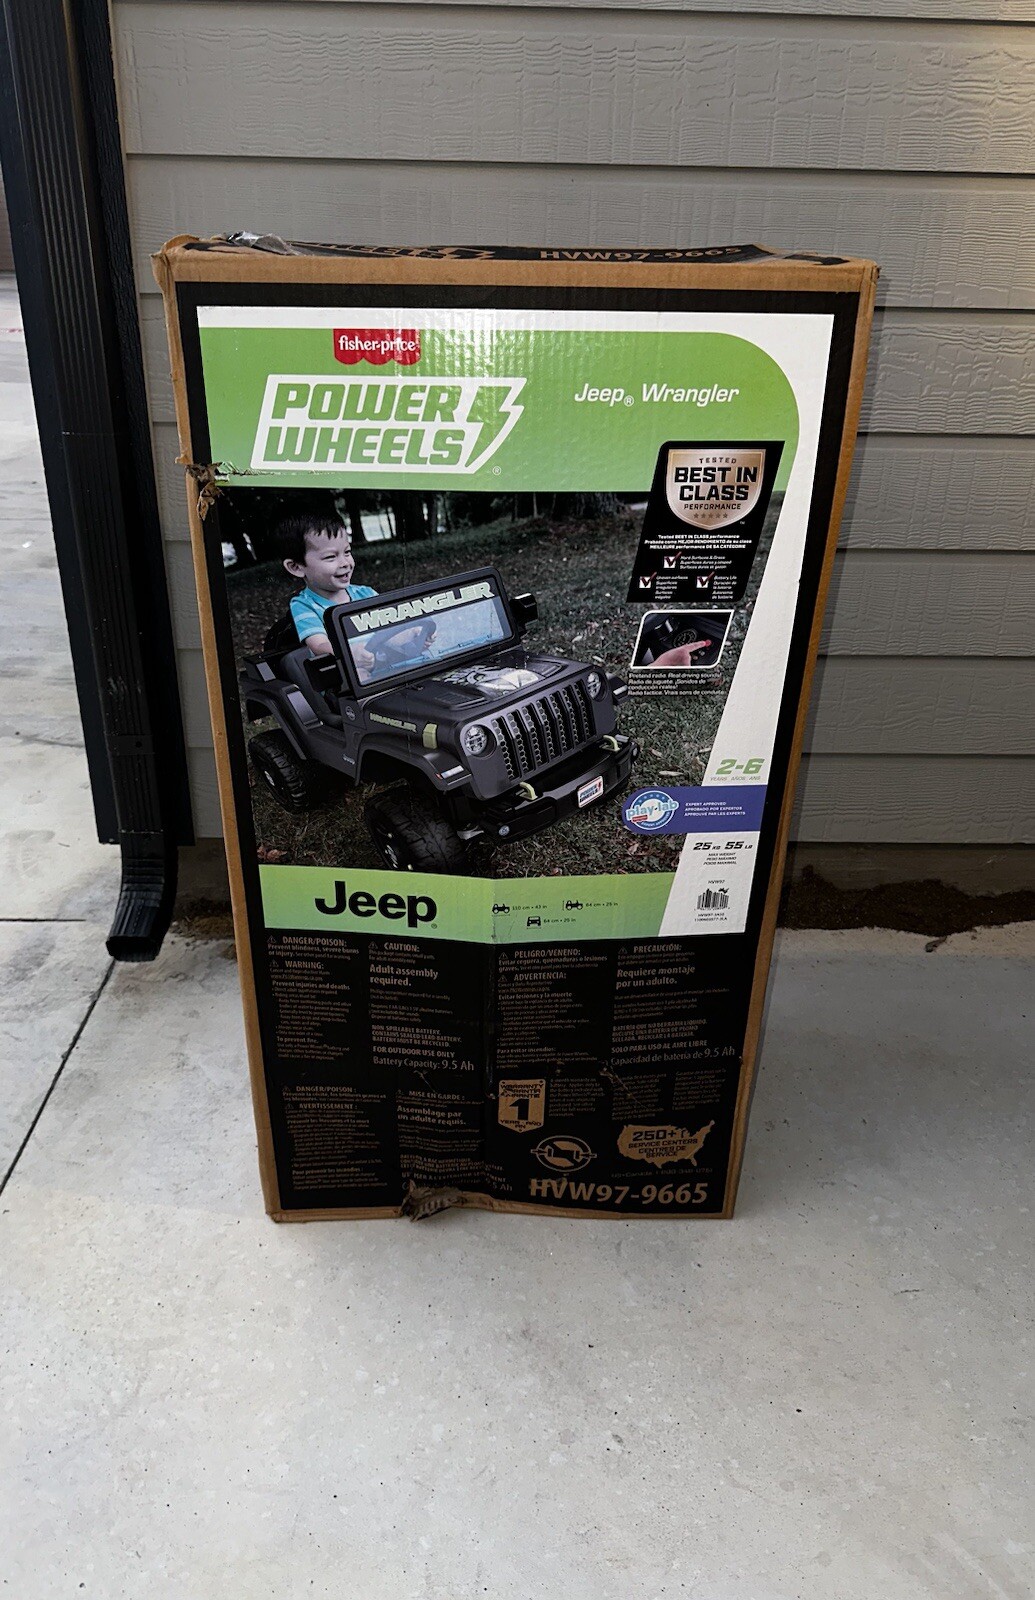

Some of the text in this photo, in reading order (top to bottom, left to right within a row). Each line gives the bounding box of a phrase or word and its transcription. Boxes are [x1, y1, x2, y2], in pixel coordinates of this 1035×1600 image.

[270, 382, 463, 423] POWER
[641, 383, 740, 408] Wrangler
[263, 425, 467, 467] WHEELS
[675, 466, 759, 483] BEST IN
[680, 485, 750, 501] CLASS
[350, 581, 495, 632] WRANGLER
[370, 712, 417, 732] WRANGLER
[715, 758, 765, 775] 2-6
[693, 842, 712, 850] 25
[724, 841, 745, 849] 55
[282, 936, 347, 947] DANGER/POISON:
[384, 942, 420, 952] CAUTION:
[633, 943, 682, 953] PRECAUCIÓN:
[514, 948, 581, 958] PELIGRO/VENENO:
[285, 960, 324, 970] WARNING:
[617, 965, 696, 979] Requiere montaje
[370, 964, 439, 981] Adult assembly
[513, 972, 567, 981] ADVERTENCIA:
[370, 976, 412, 987] required.
[616, 980, 631, 991] por
[646, 976, 678, 985] adulto.
[689, 1039, 708, 1047] LIBRE
[387, 1047, 421, 1055] OUTDOOR
[611, 1056, 650, 1068] Capacidad
[652, 1054, 661, 1062] de
[692, 1051, 702, 1059] de
[703, 1047, 719, 1058] 9.5
[721, 1045, 736, 1056] Ah
[372, 1056, 475, 1071] Battery Capacity: 9.5 Ah
[397, 1105, 462, 1119] Assemblage par
[509, 1098, 529, 1121] 1
[410, 1114, 437, 1124] adulte
[438, 1118, 466, 1127] requis.
[632, 1129, 676, 1141] 250+
[628, 1137, 698, 1149] SERVICE CENTERS
[530, 1177, 709, 1205] HVW97-9665
